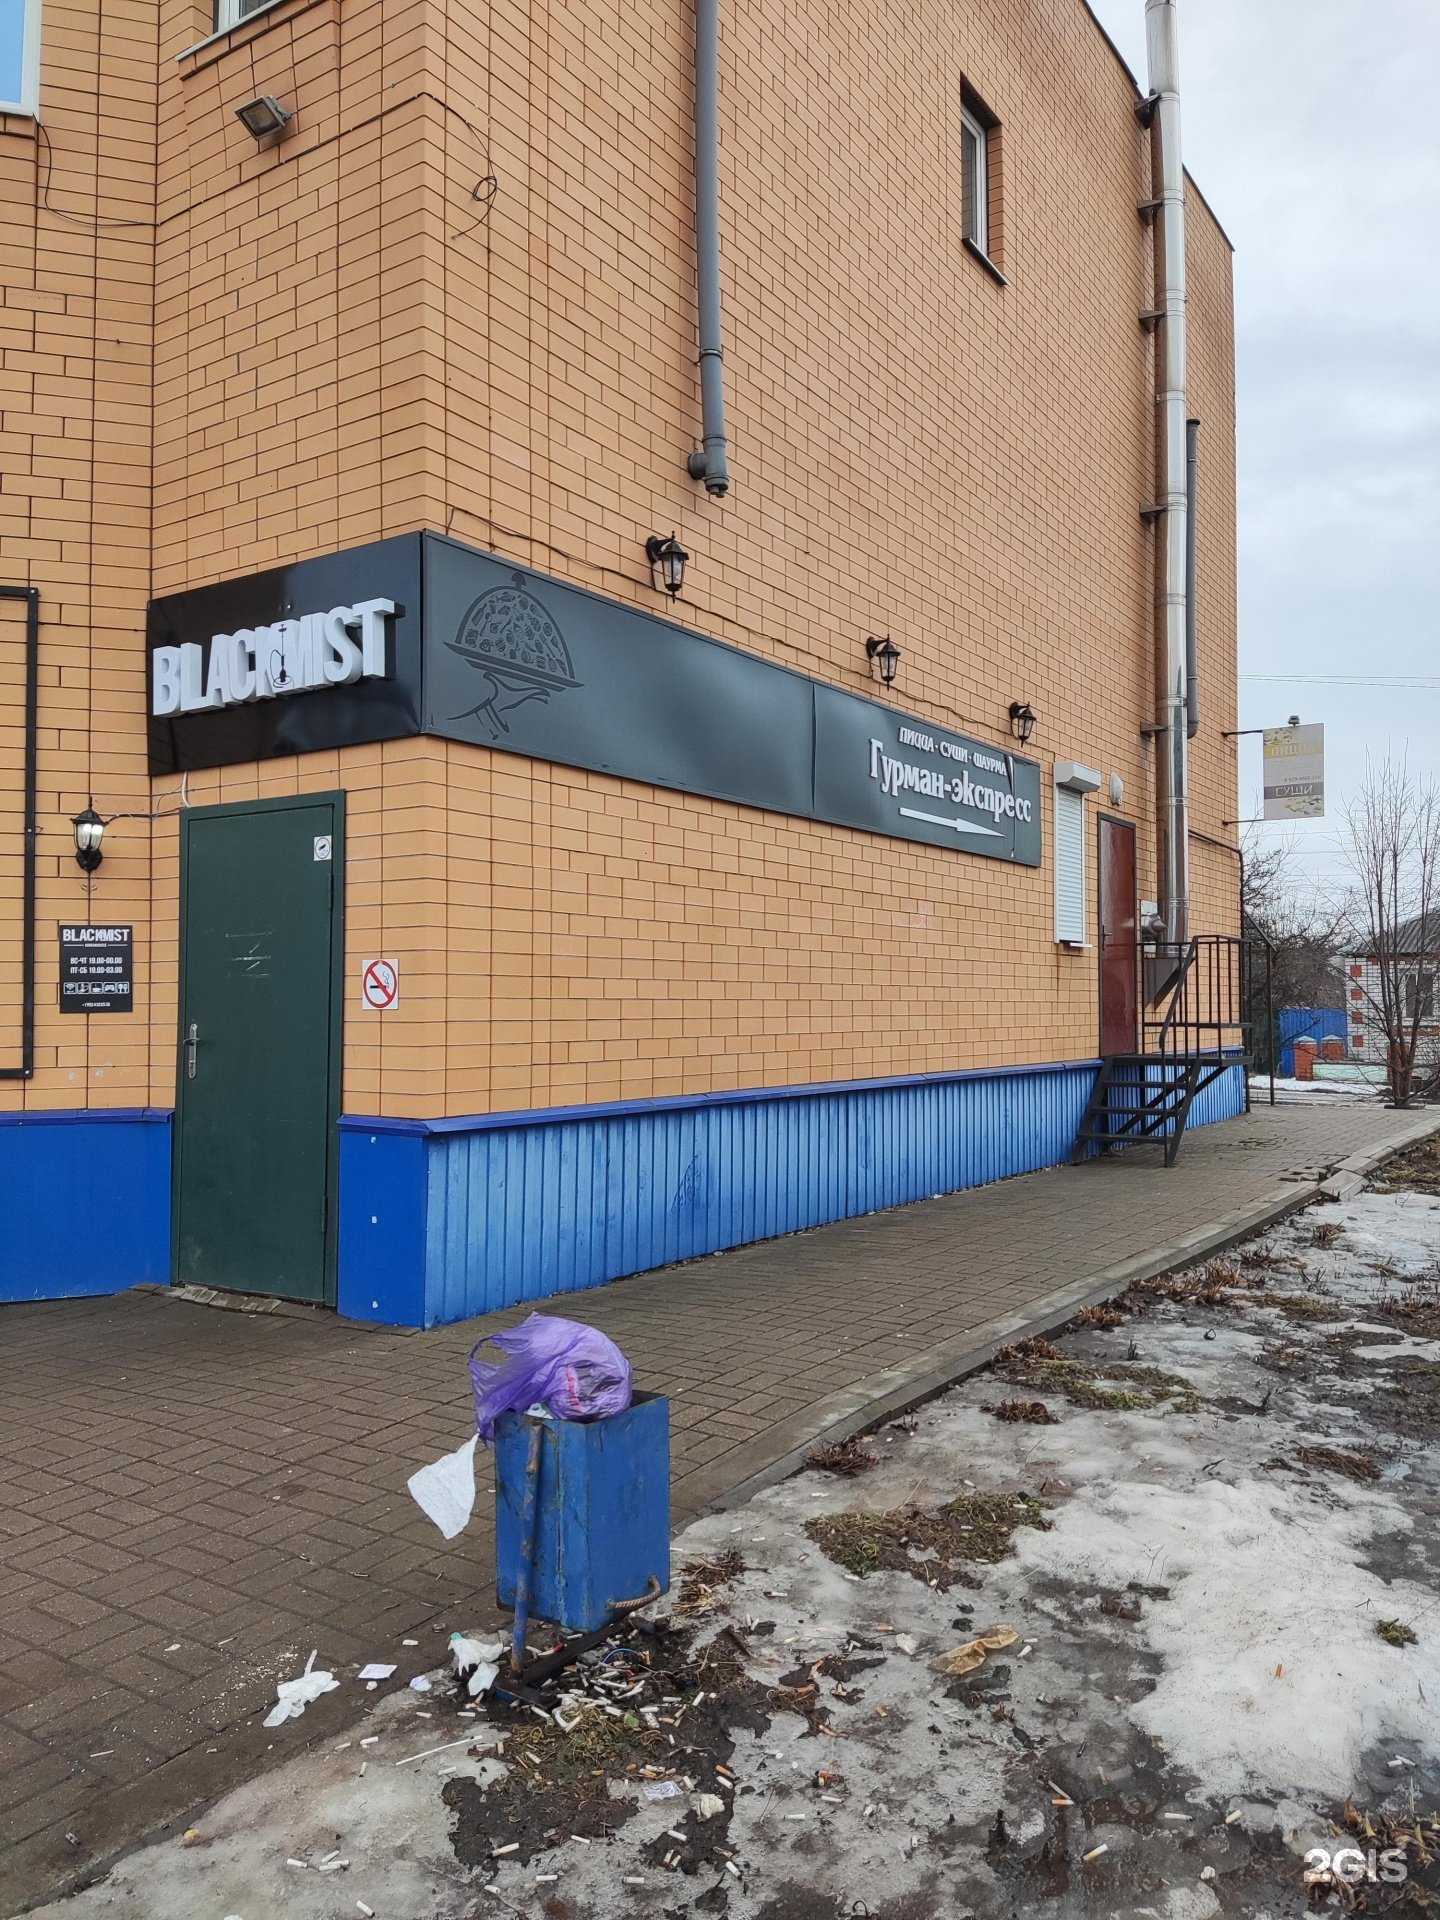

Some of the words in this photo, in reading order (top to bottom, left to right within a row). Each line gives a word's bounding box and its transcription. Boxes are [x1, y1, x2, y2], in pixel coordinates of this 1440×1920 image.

[153, 597, 396, 716] BLACKMIST
[899, 727, 935, 752] ПИЦЦА
[939, 741, 968, 763] СУШИ
[972, 752, 1008, 777] ШАУРМА
[1275, 784, 1313, 798] СУШИ
